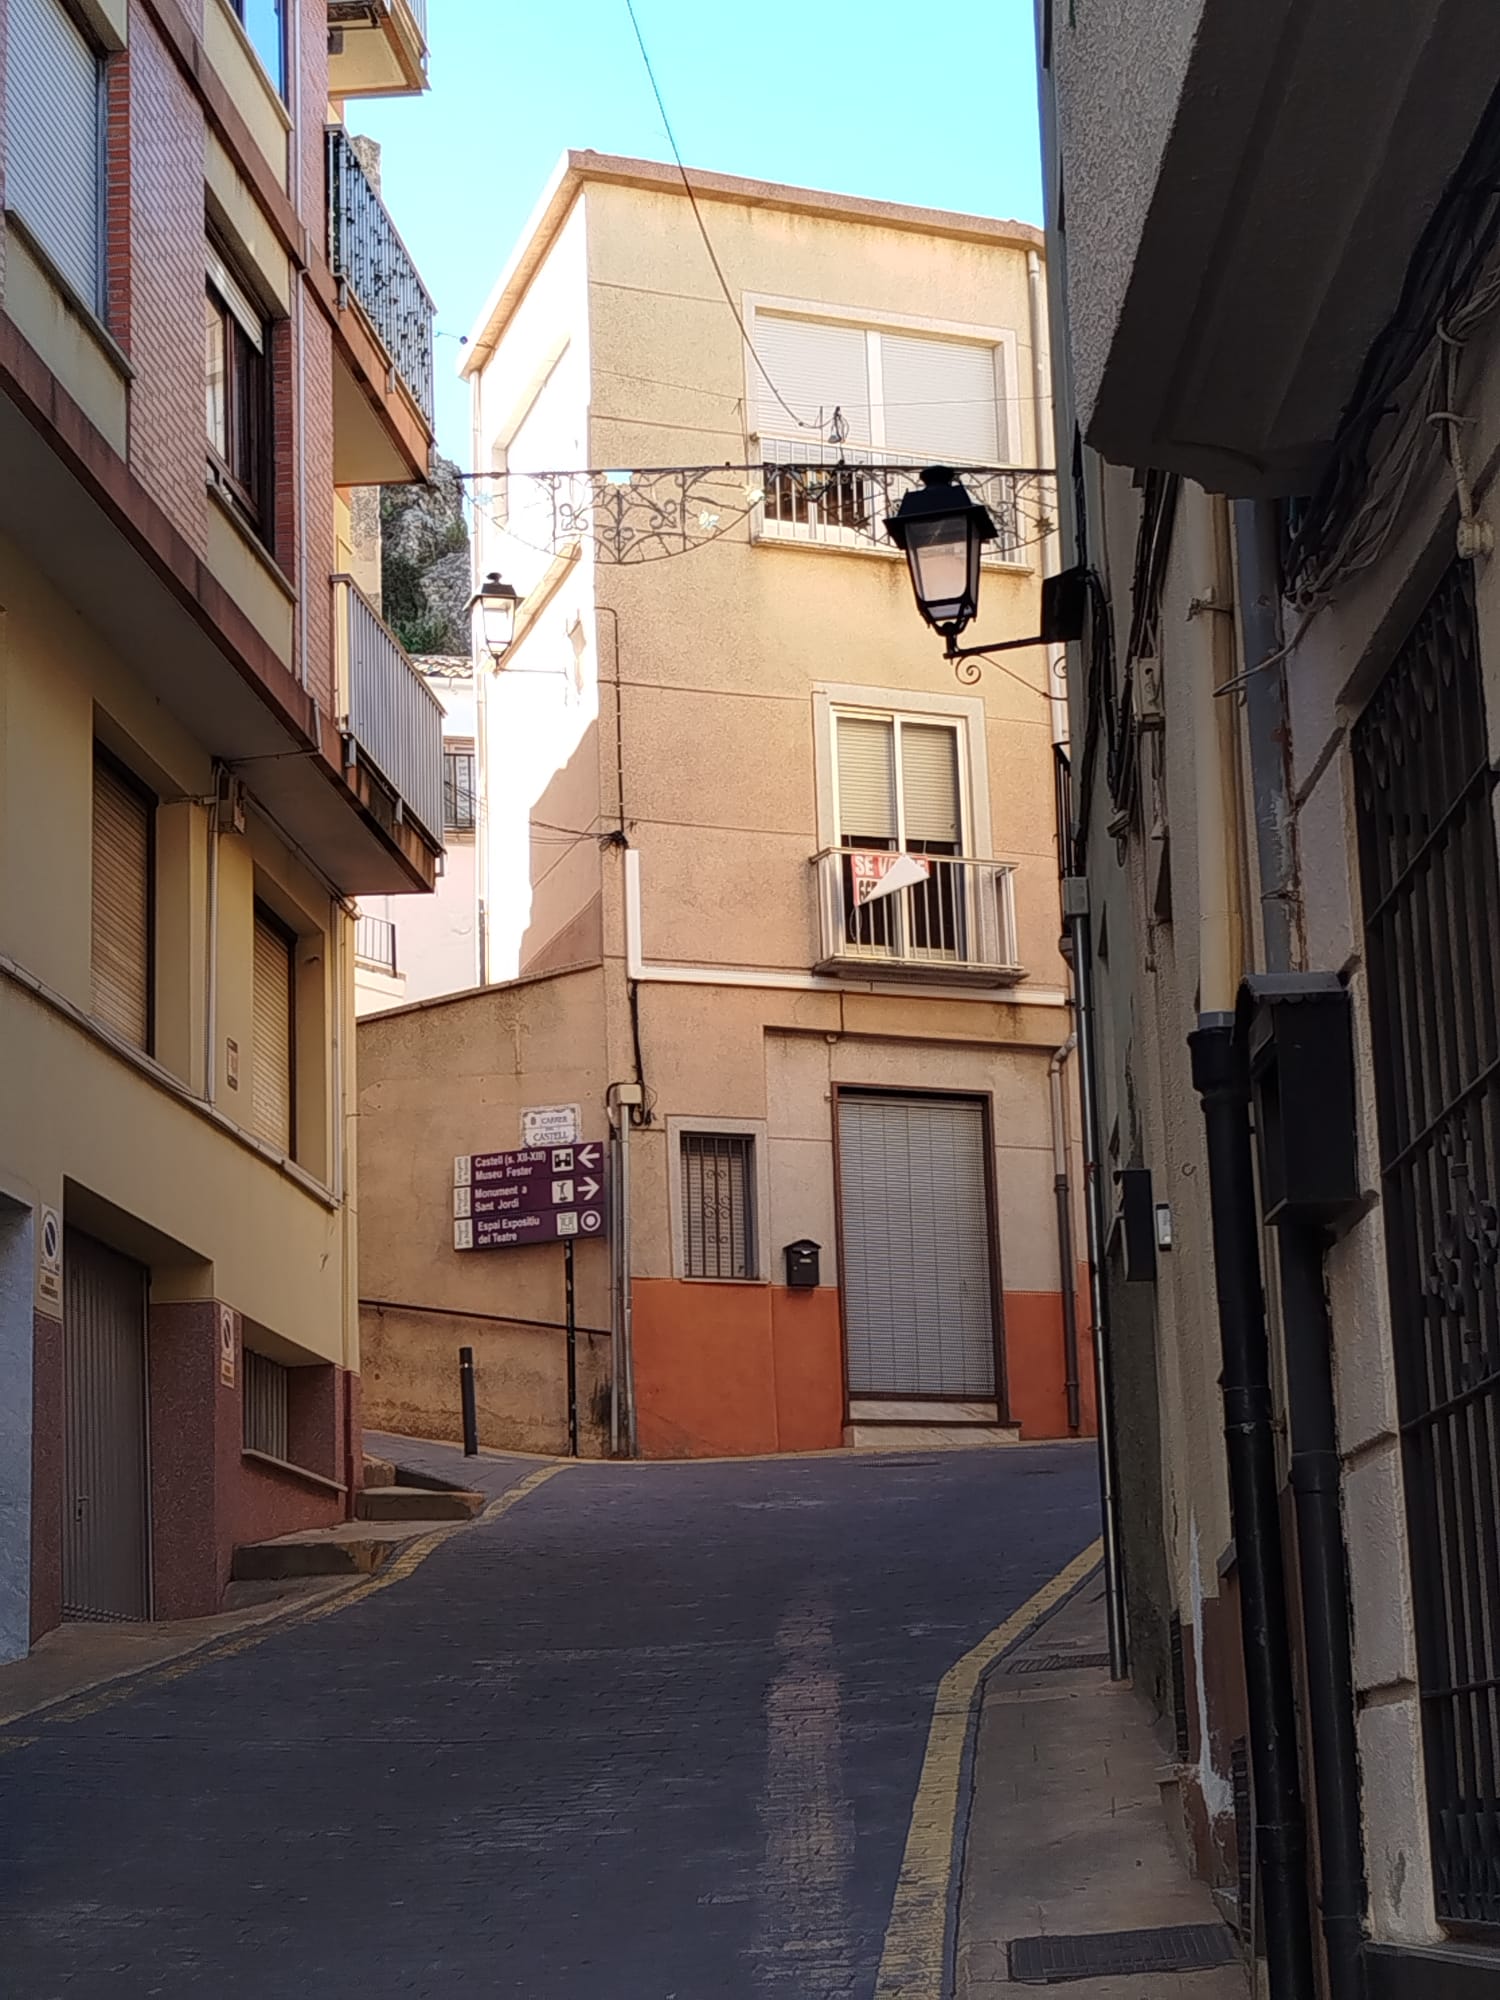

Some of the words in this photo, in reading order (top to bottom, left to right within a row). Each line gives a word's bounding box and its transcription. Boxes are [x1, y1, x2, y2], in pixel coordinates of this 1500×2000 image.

[855, 855, 875, 876] SE
[533, 1131, 569, 1141] CASTELL
[474, 1155, 503, 1167] Castell
[475, 1170, 503, 1180] Museu
[506, 1166, 533, 1177] Fester
[474, 1186, 518, 1199] Monument
[521, 1186, 528, 1194] a
[474, 1201, 494, 1212] Sant
[497, 1198, 519, 1210] Jordi
[477, 1220, 500, 1232] Espai
[501, 1216, 540, 1230] Expositiu
[478, 1234, 491, 1244] del
[492, 1232, 517, 1242] Teatre
